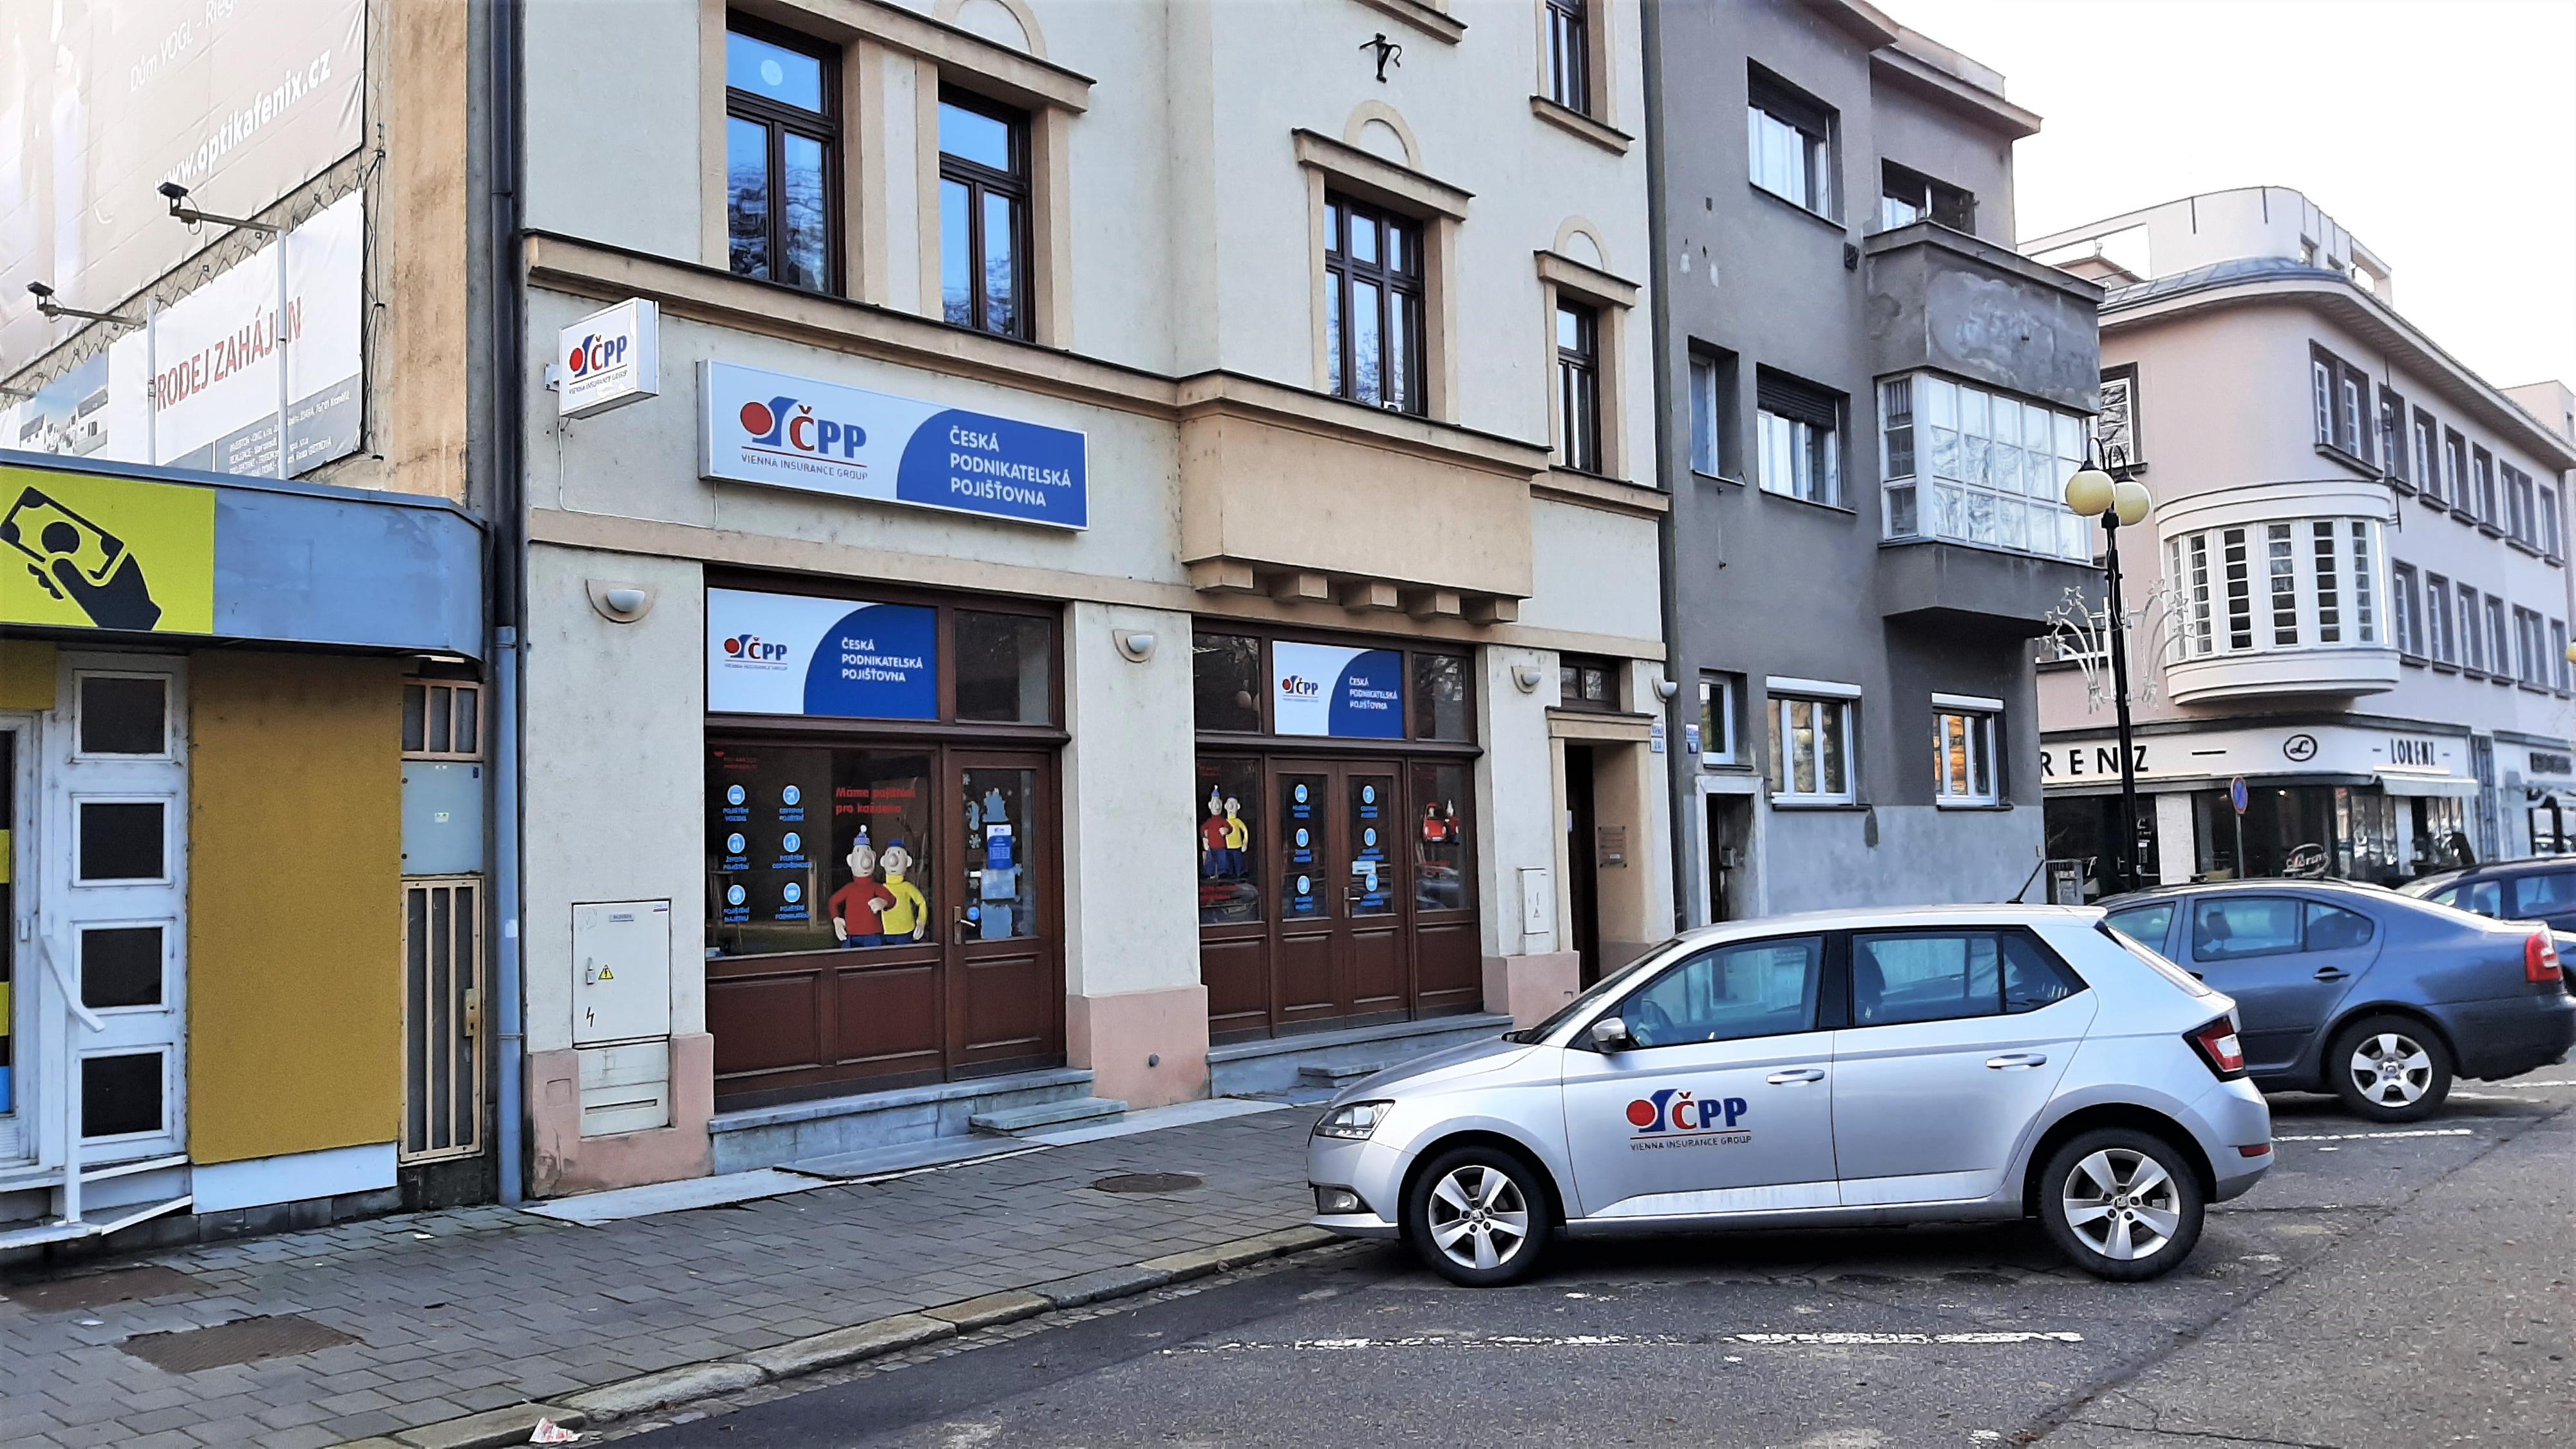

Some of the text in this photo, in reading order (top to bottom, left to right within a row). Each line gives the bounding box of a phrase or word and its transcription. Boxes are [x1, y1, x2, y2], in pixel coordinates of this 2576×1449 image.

[160, 19, 193, 65] VOGL
[157, 348, 209, 412] RODEJ
[214, 296, 301, 383] ZAHÁJN
[591, 335, 627, 370] ČPP
[790, 404, 866, 459] ČPP
[950, 425, 999, 452] ČESKÁ
[741, 454, 868, 480] VIENNA INSURANCE GROUP
[950, 452, 1072, 488] PODNIKATELSKÁ
[951, 477, 1046, 507] POJIŠŤOVNA
[748, 636, 788, 661] ČPP
[842, 637, 875, 651] ČESKÁ
[842, 654, 923, 669] PODNIKATELSKÁ
[842, 667, 906, 683] POJIŠŤOVNA
[1296, 677, 1319, 696] ČPP
[2390, 738, 2436, 766] LORENZ
[1672, 1091, 1748, 1130] ČPP
[1630, 1135, 1752, 1150] VIENNA INSURANCE GROUP
